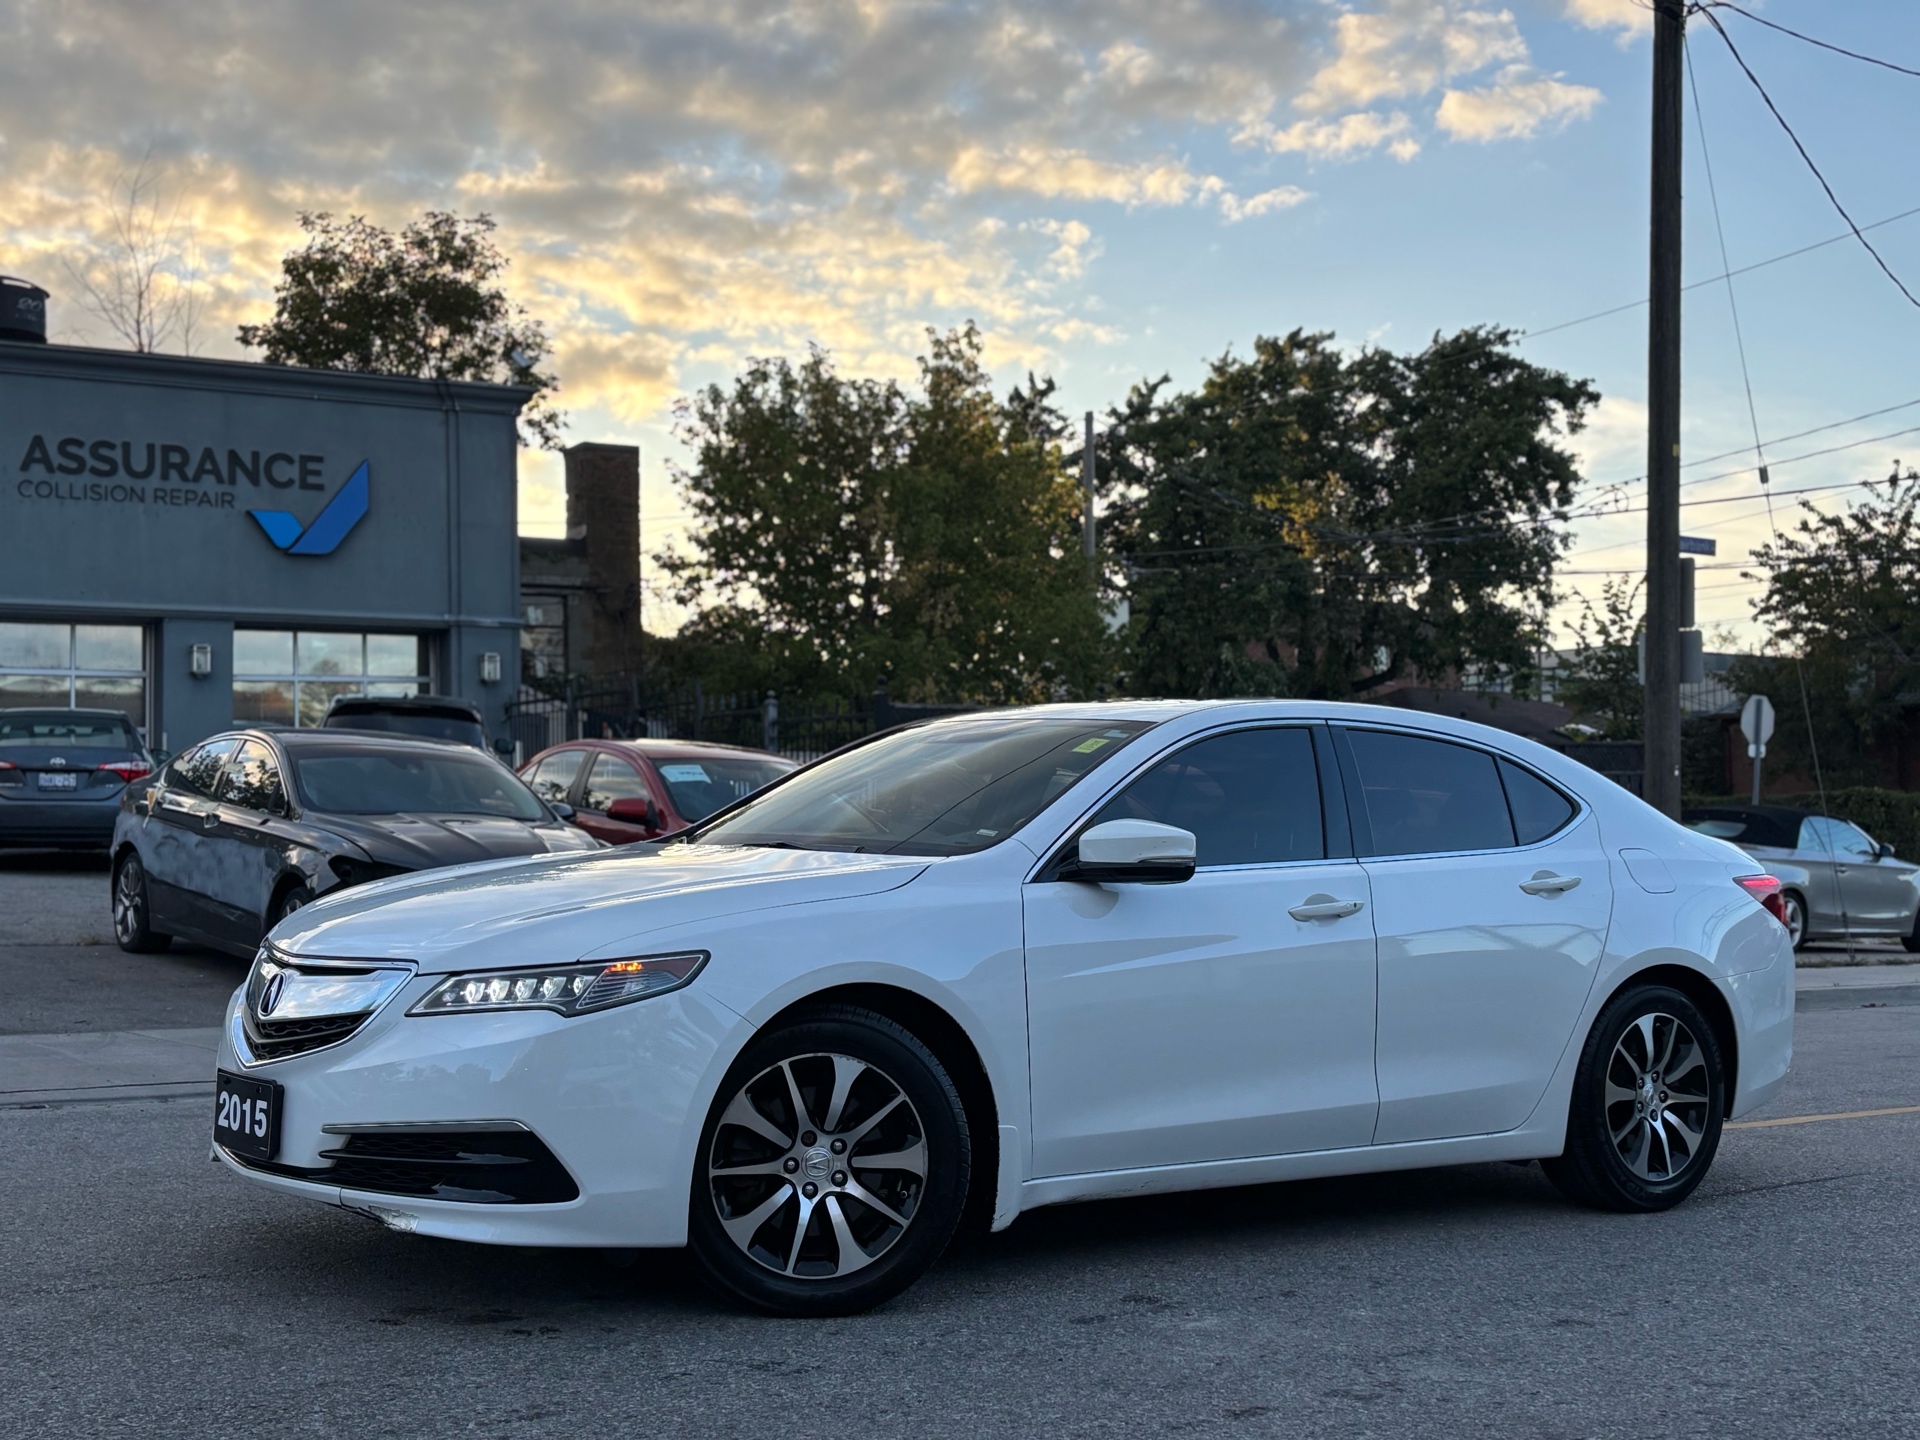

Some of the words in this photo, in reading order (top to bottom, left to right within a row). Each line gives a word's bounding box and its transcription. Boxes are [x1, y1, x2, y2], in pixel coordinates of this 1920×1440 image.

[19, 434, 325, 491] ASSURANCE
[17, 479, 146, 504] COLLISION
[153, 487, 236, 509] REPAIR
[218, 1091, 268, 1138] 2015
